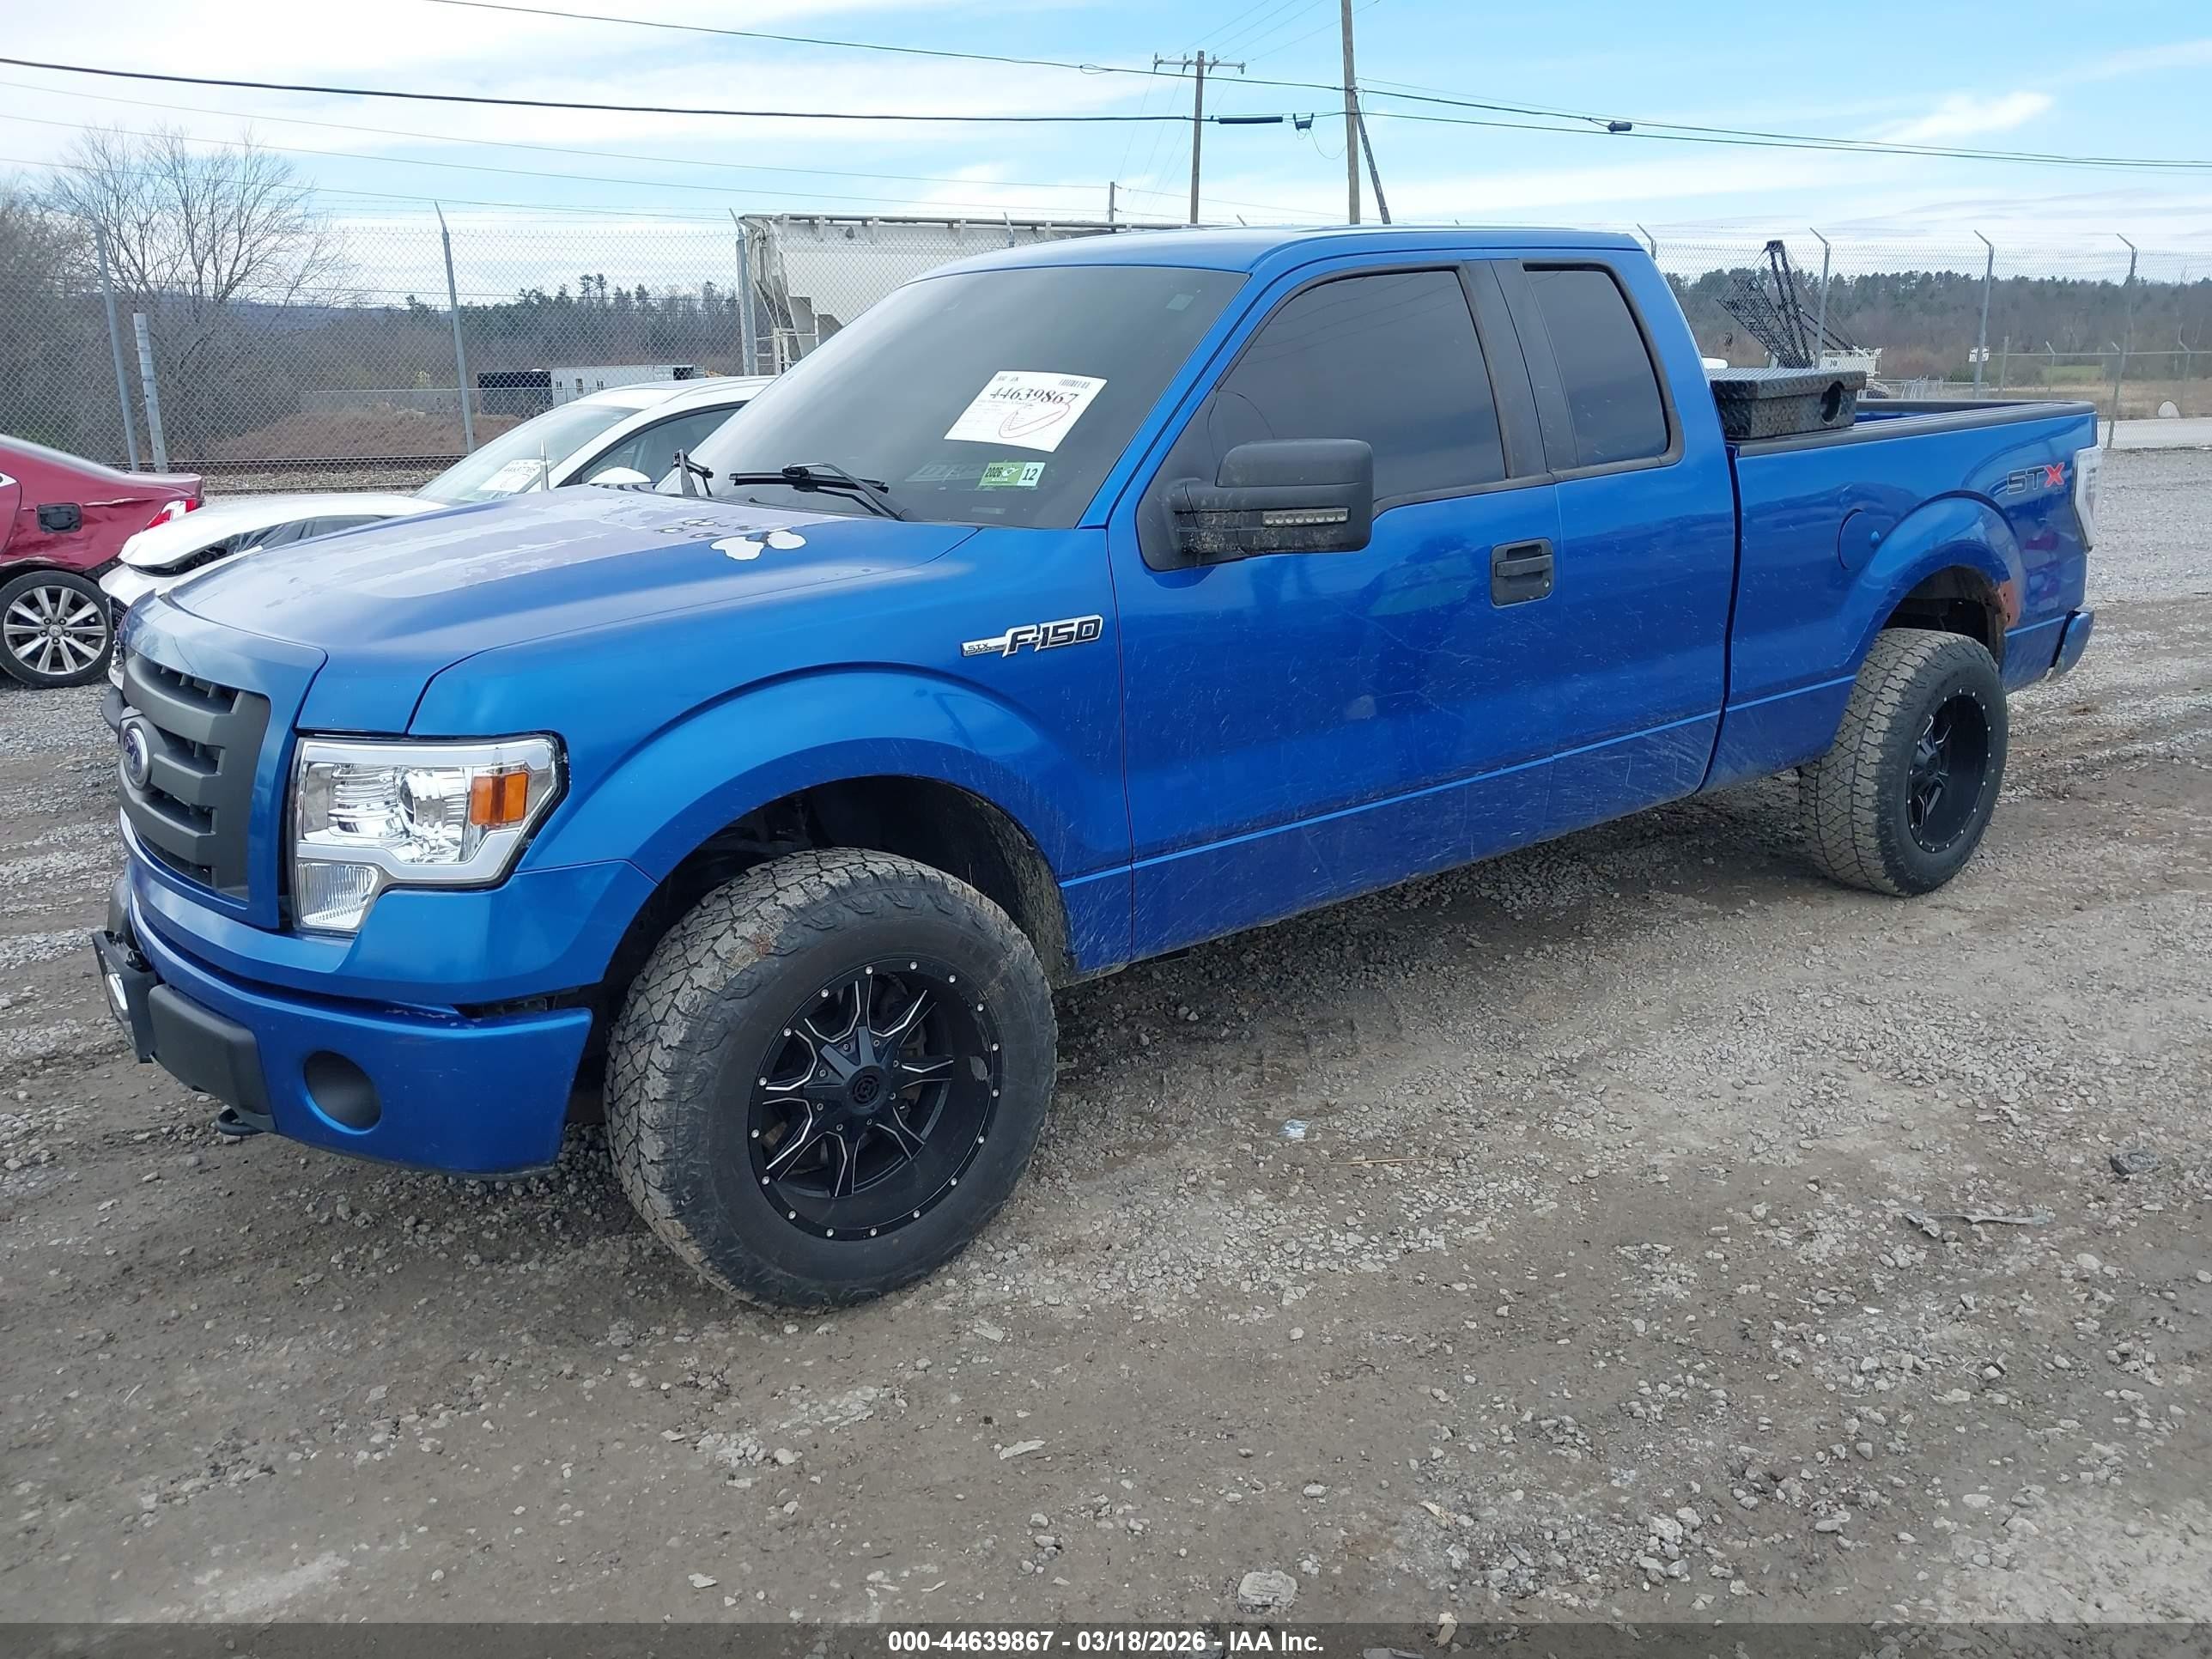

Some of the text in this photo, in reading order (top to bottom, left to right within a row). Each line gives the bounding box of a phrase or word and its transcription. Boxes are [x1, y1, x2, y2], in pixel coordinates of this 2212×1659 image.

[989, 386, 1080, 405] 44639867
[985, 466, 1038, 480] 2026 12
[2007, 462, 2065, 495] STX
[1003, 615, 1103, 657] F-150
[968, 642, 989, 652] STX
